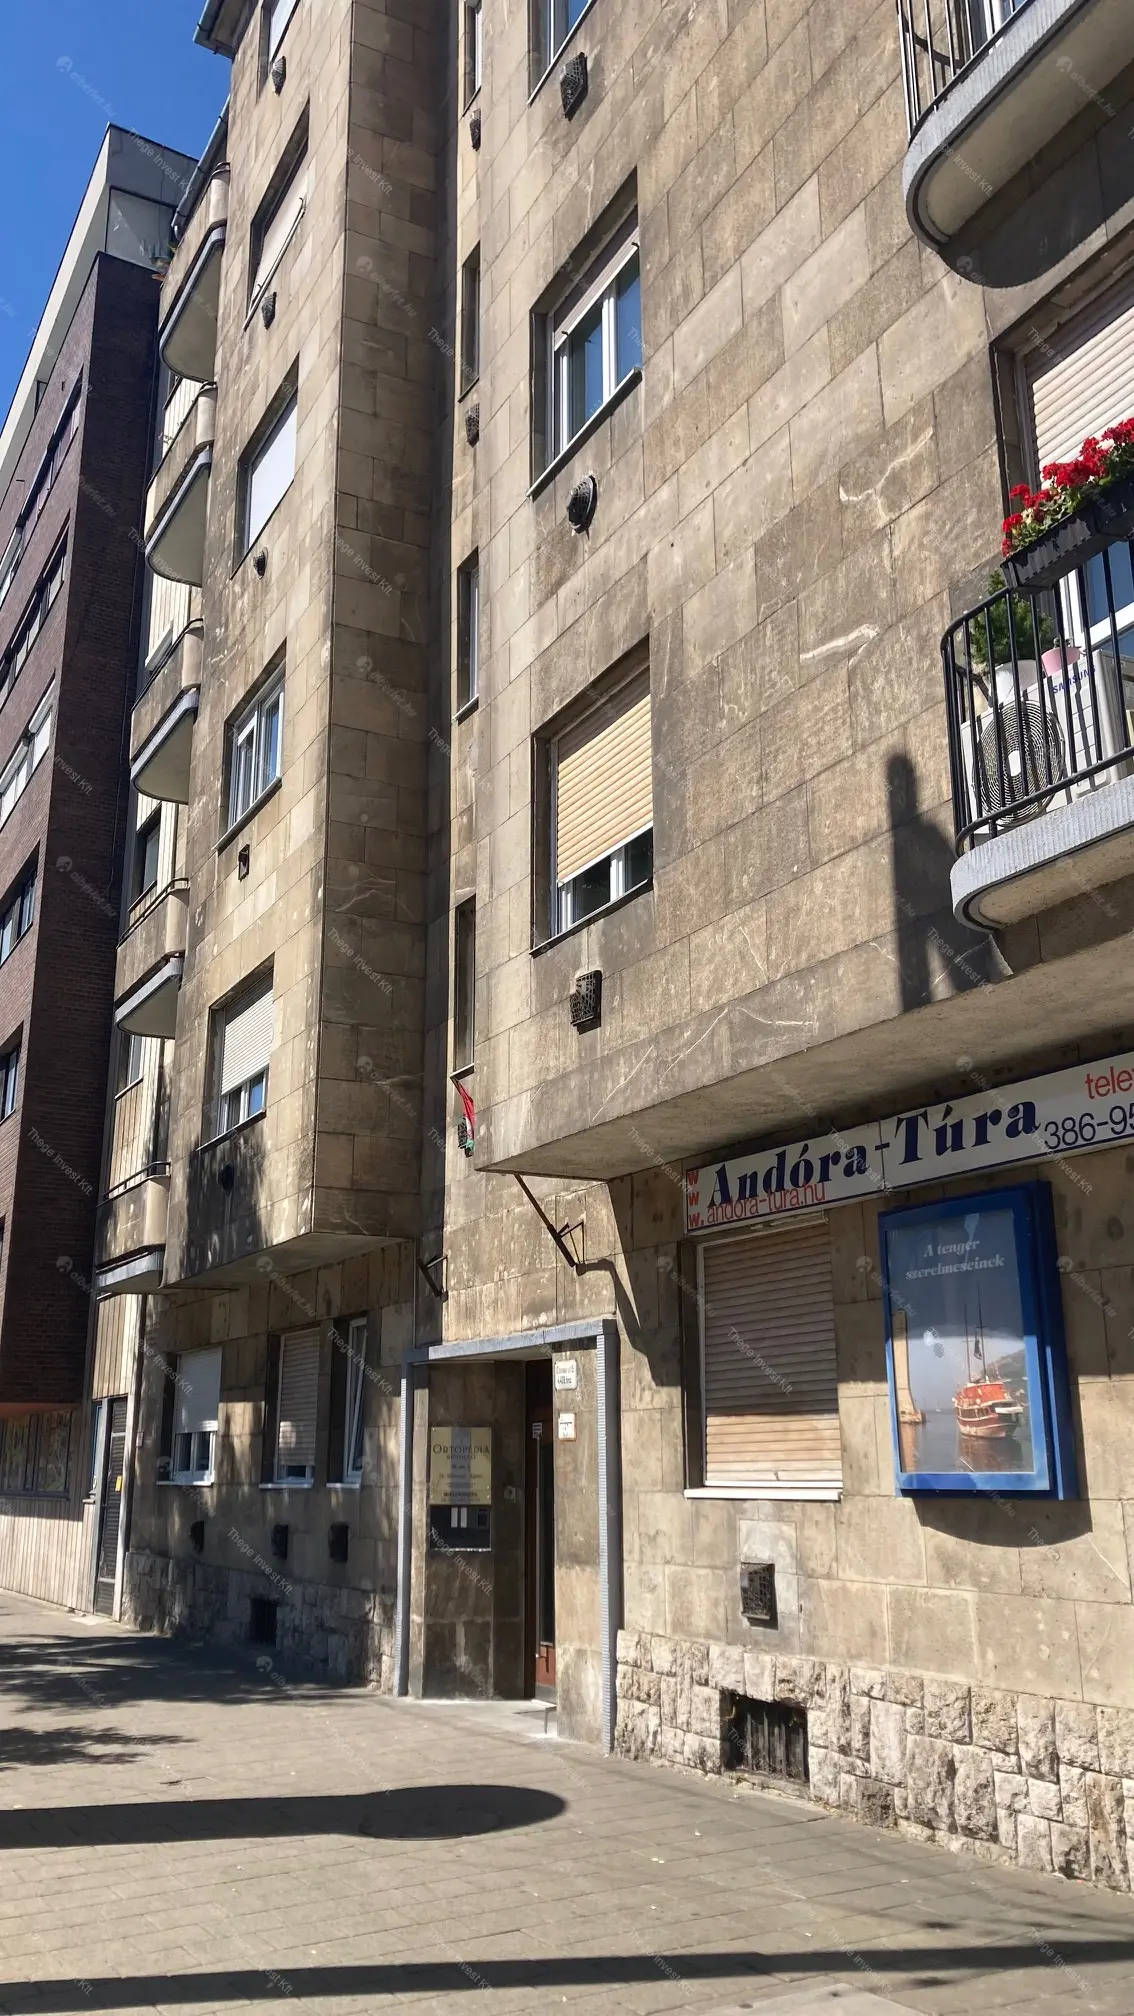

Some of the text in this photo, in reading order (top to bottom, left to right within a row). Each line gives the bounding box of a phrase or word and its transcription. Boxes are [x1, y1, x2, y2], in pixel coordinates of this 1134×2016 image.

[1085, 1066, 1134, 1099] tele
[1045, 1103, 1134, 1150] 386-9
[707, 1100, 1042, 1207] Andóra-Túra
[924, 1240, 980, 1257] A tenger
[905, 1254, 1005, 1280] szerelmeseinek
